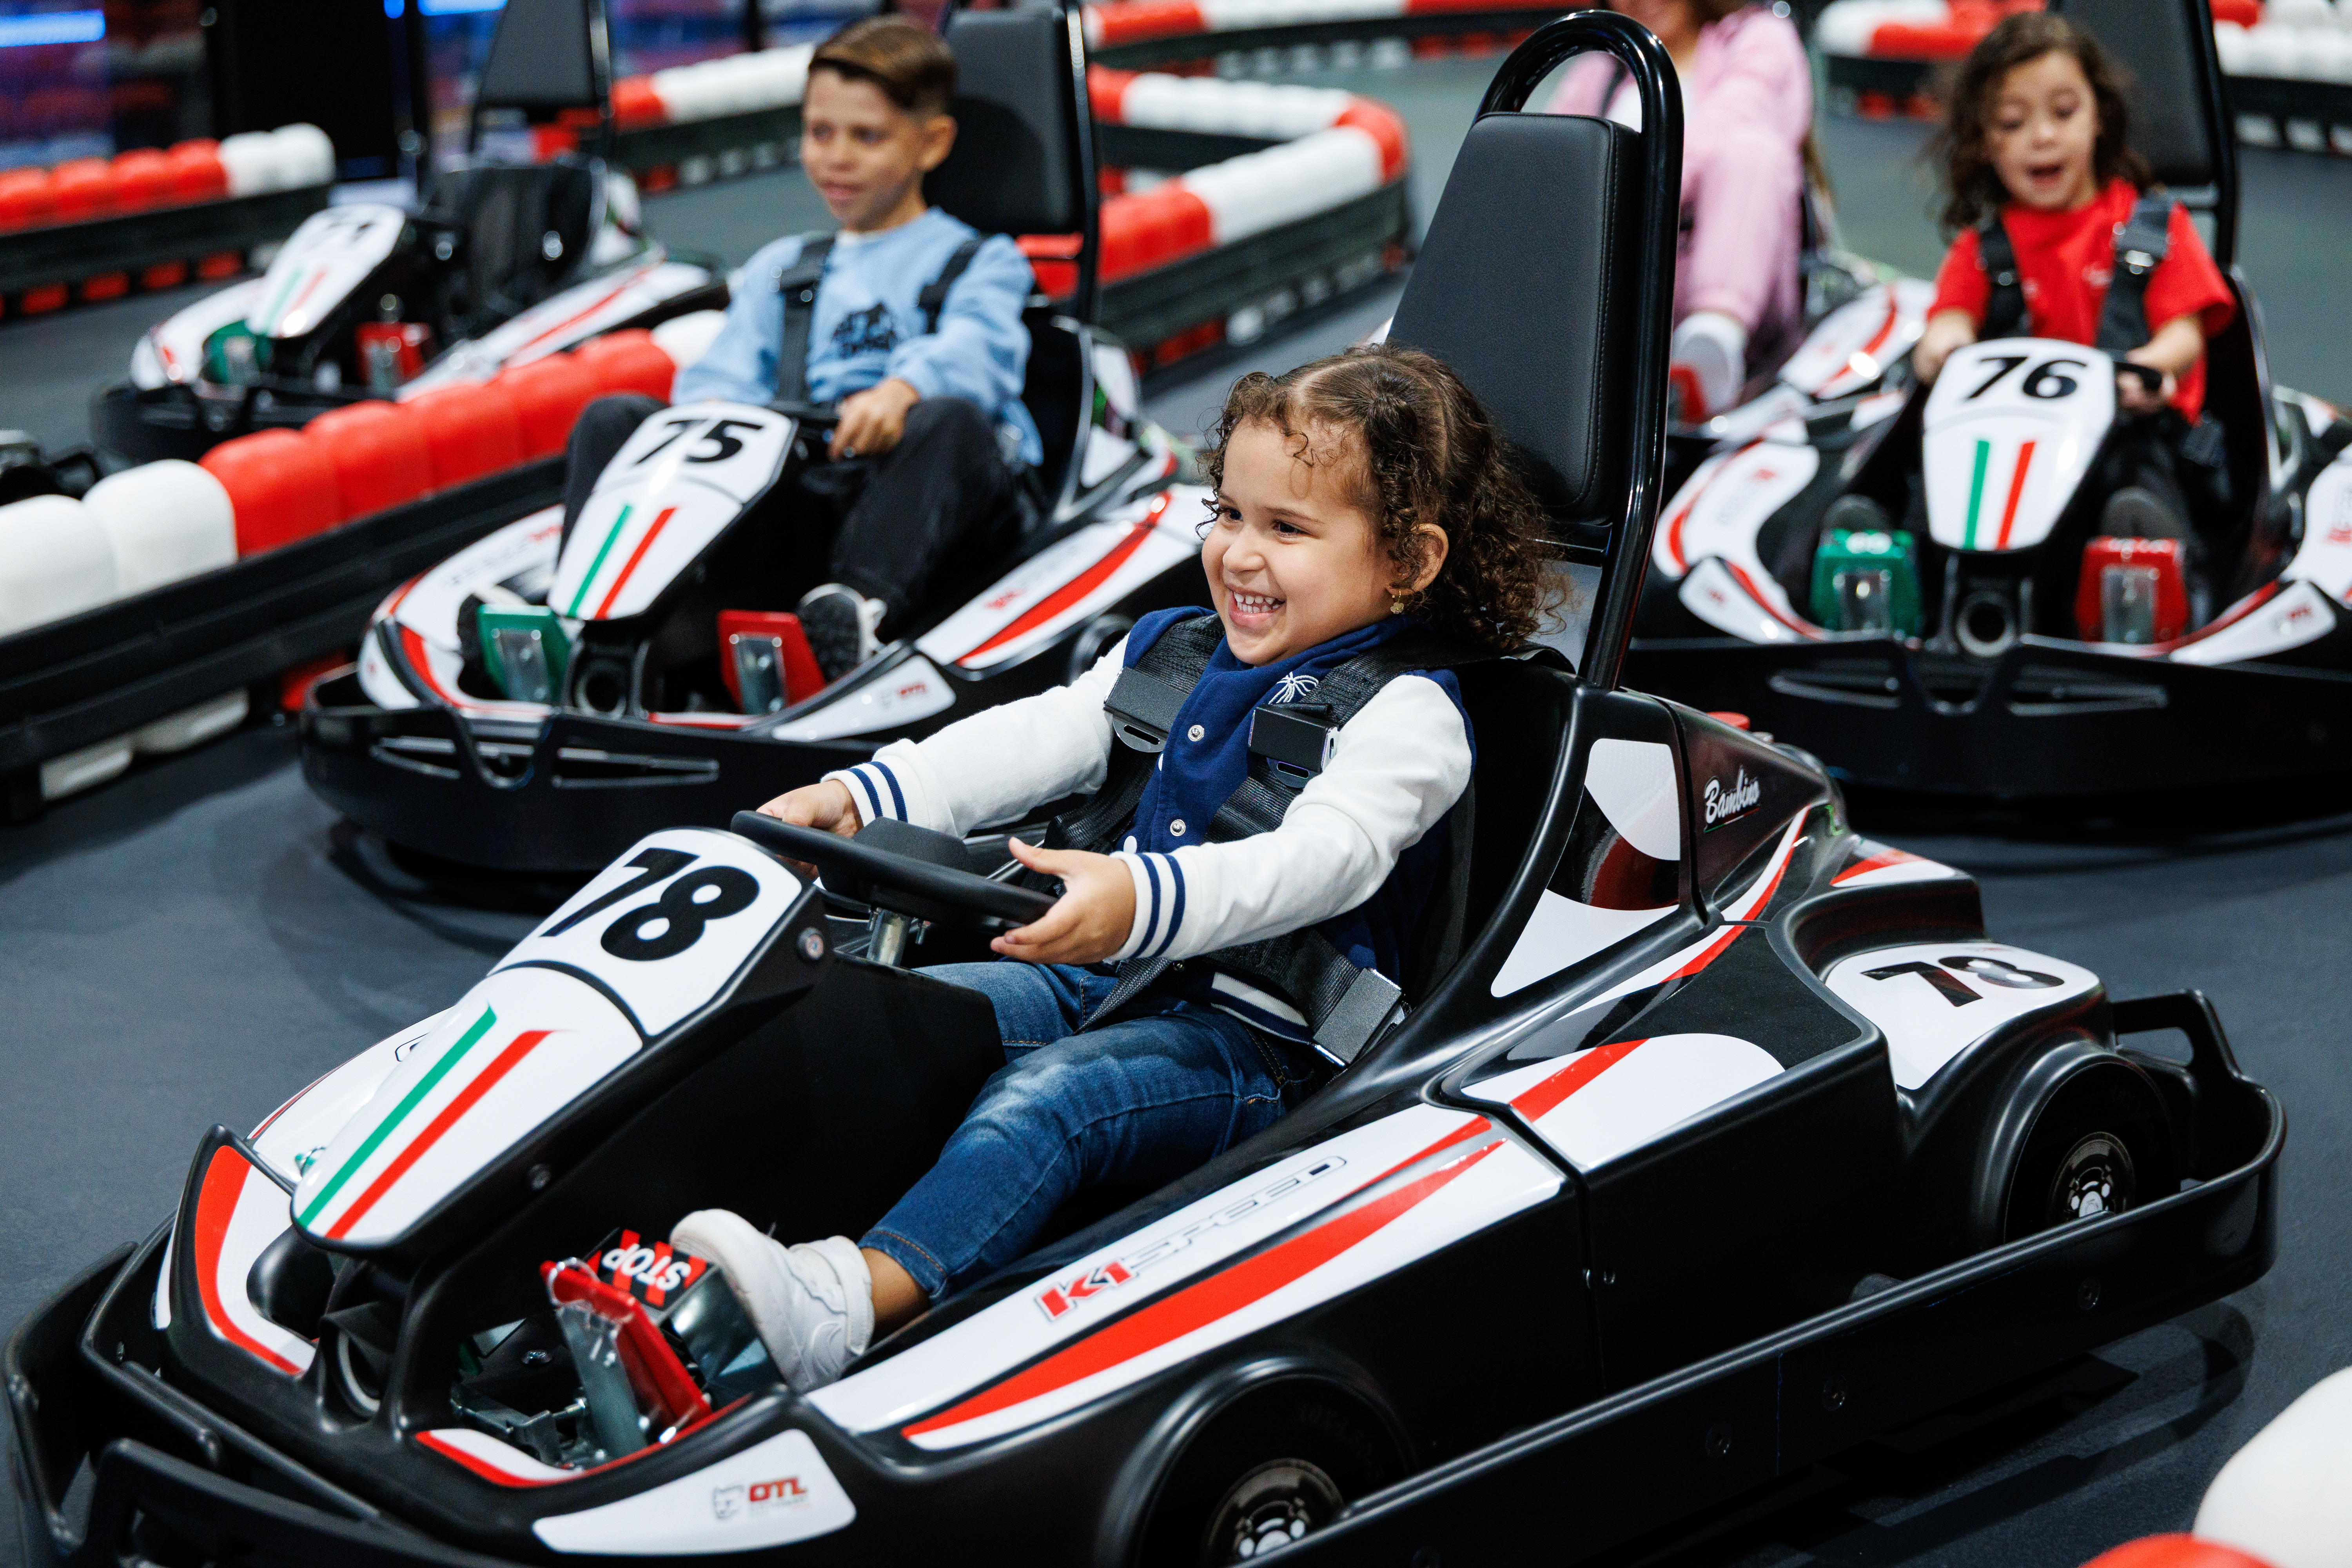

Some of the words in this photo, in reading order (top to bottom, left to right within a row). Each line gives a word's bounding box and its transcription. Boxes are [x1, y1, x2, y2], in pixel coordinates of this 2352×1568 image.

[1965, 356, 2088, 400] 76
[633, 418, 764, 465] 75
[538, 847, 760, 961] 78
[1860, 956, 2065, 1007] 78
[601, 1243, 692, 1291] STOP
[749, 1475, 808, 1503] OTL
